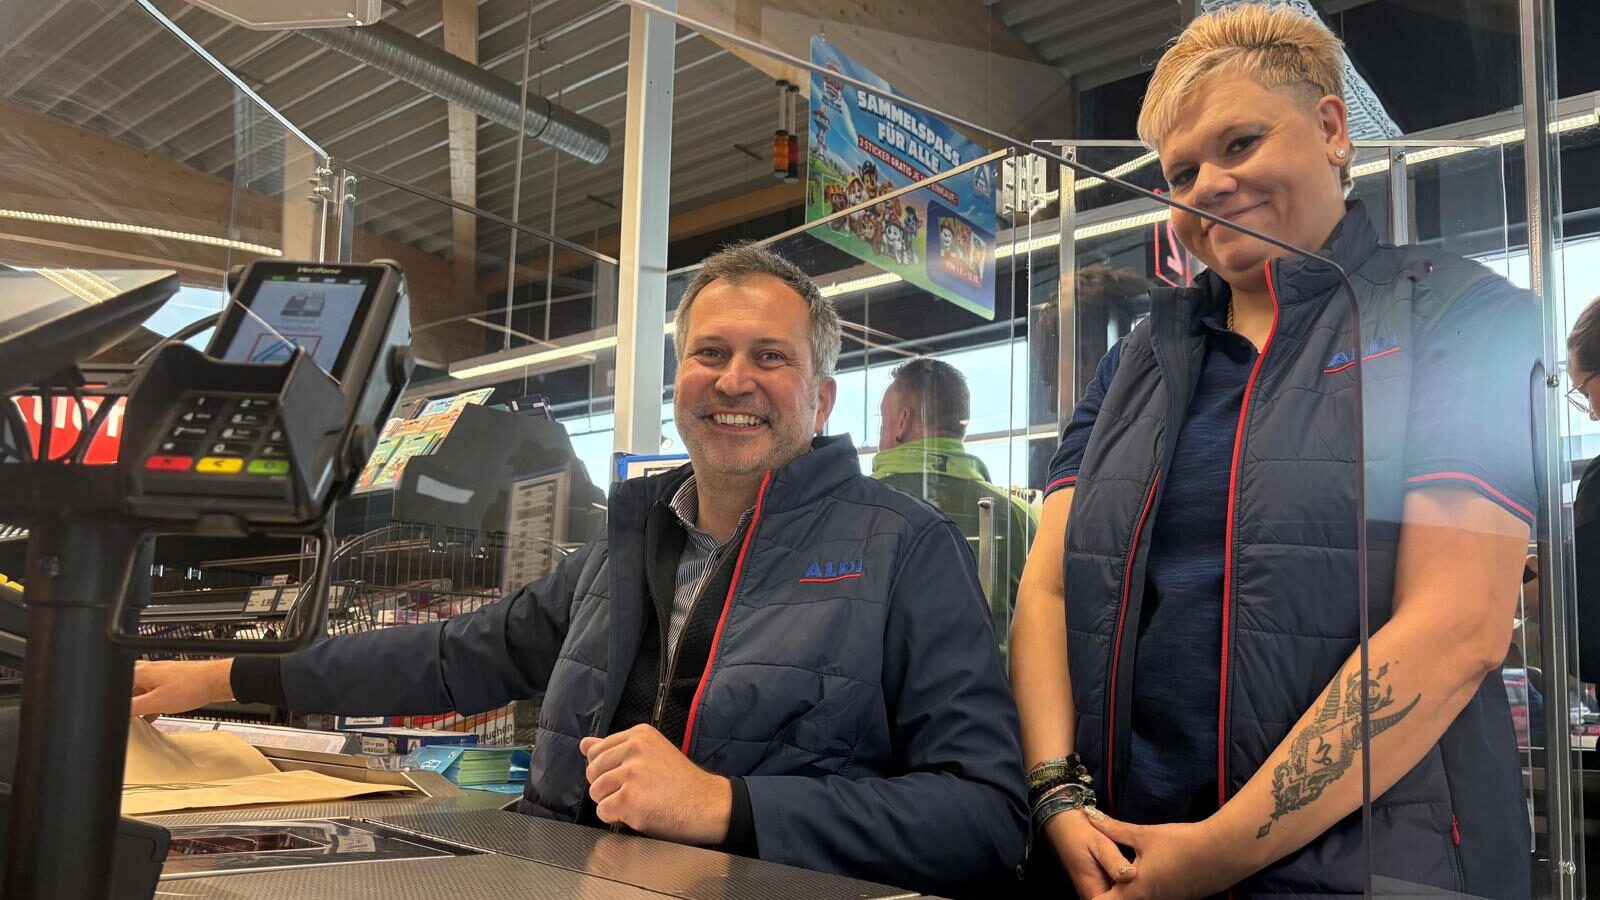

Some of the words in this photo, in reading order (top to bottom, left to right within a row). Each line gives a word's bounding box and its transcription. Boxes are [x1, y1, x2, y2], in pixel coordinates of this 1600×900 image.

[857, 90, 961, 167] SAMMELSPASS
[878, 121, 906, 152] FÜR
[908, 139, 940, 174] ALLE
[864, 141, 891, 163] STICKER
[890, 156, 912, 177] GRATIS
